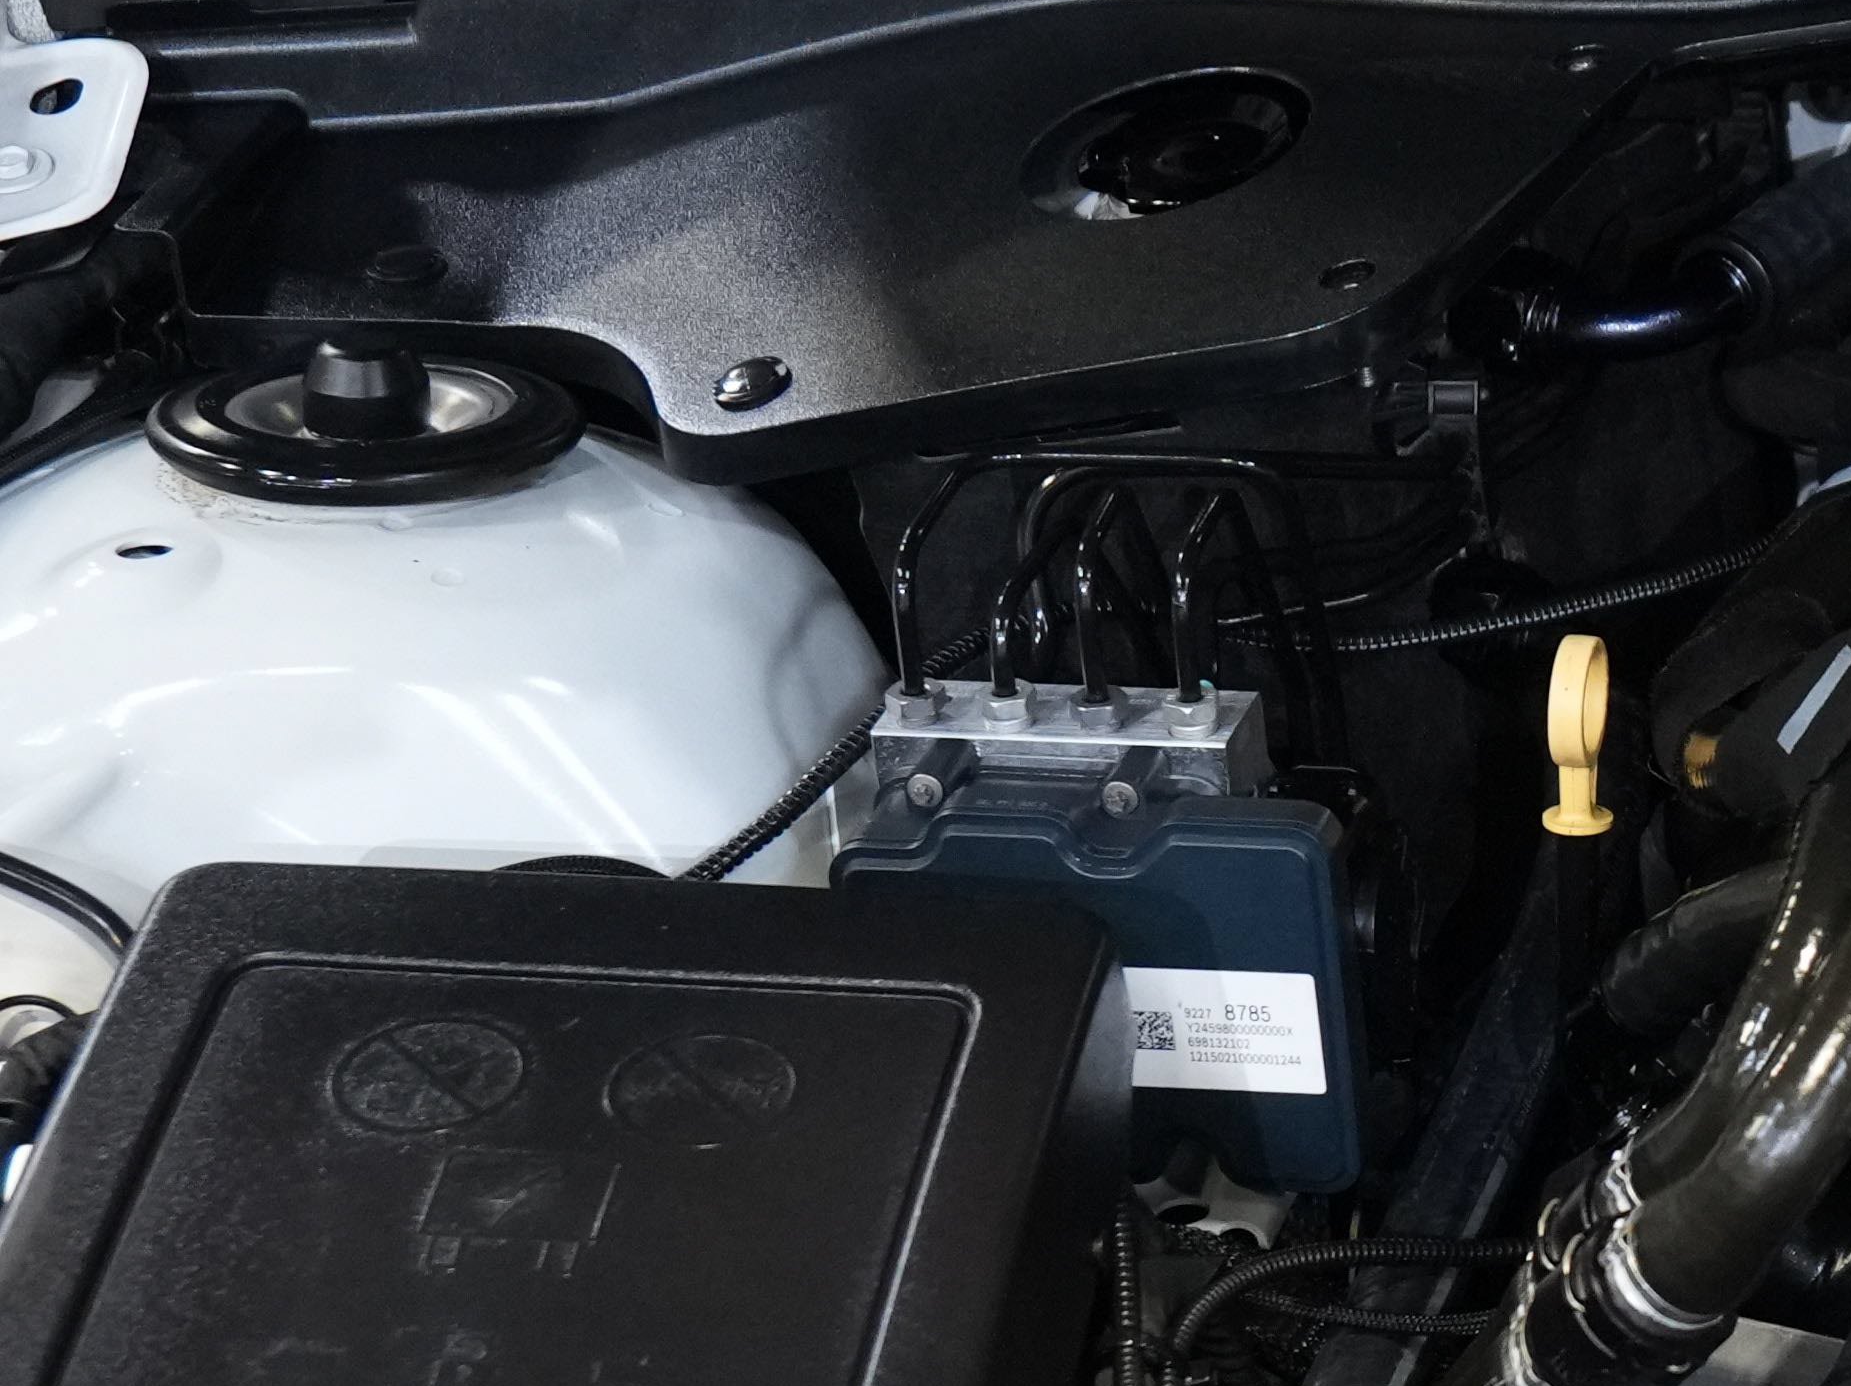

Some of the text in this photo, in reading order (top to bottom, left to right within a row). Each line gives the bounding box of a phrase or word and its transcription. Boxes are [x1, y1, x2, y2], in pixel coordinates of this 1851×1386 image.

[1183, 1003, 1272, 1023] 9227 8785
[1187, 1036, 1251, 1049] 698132102
